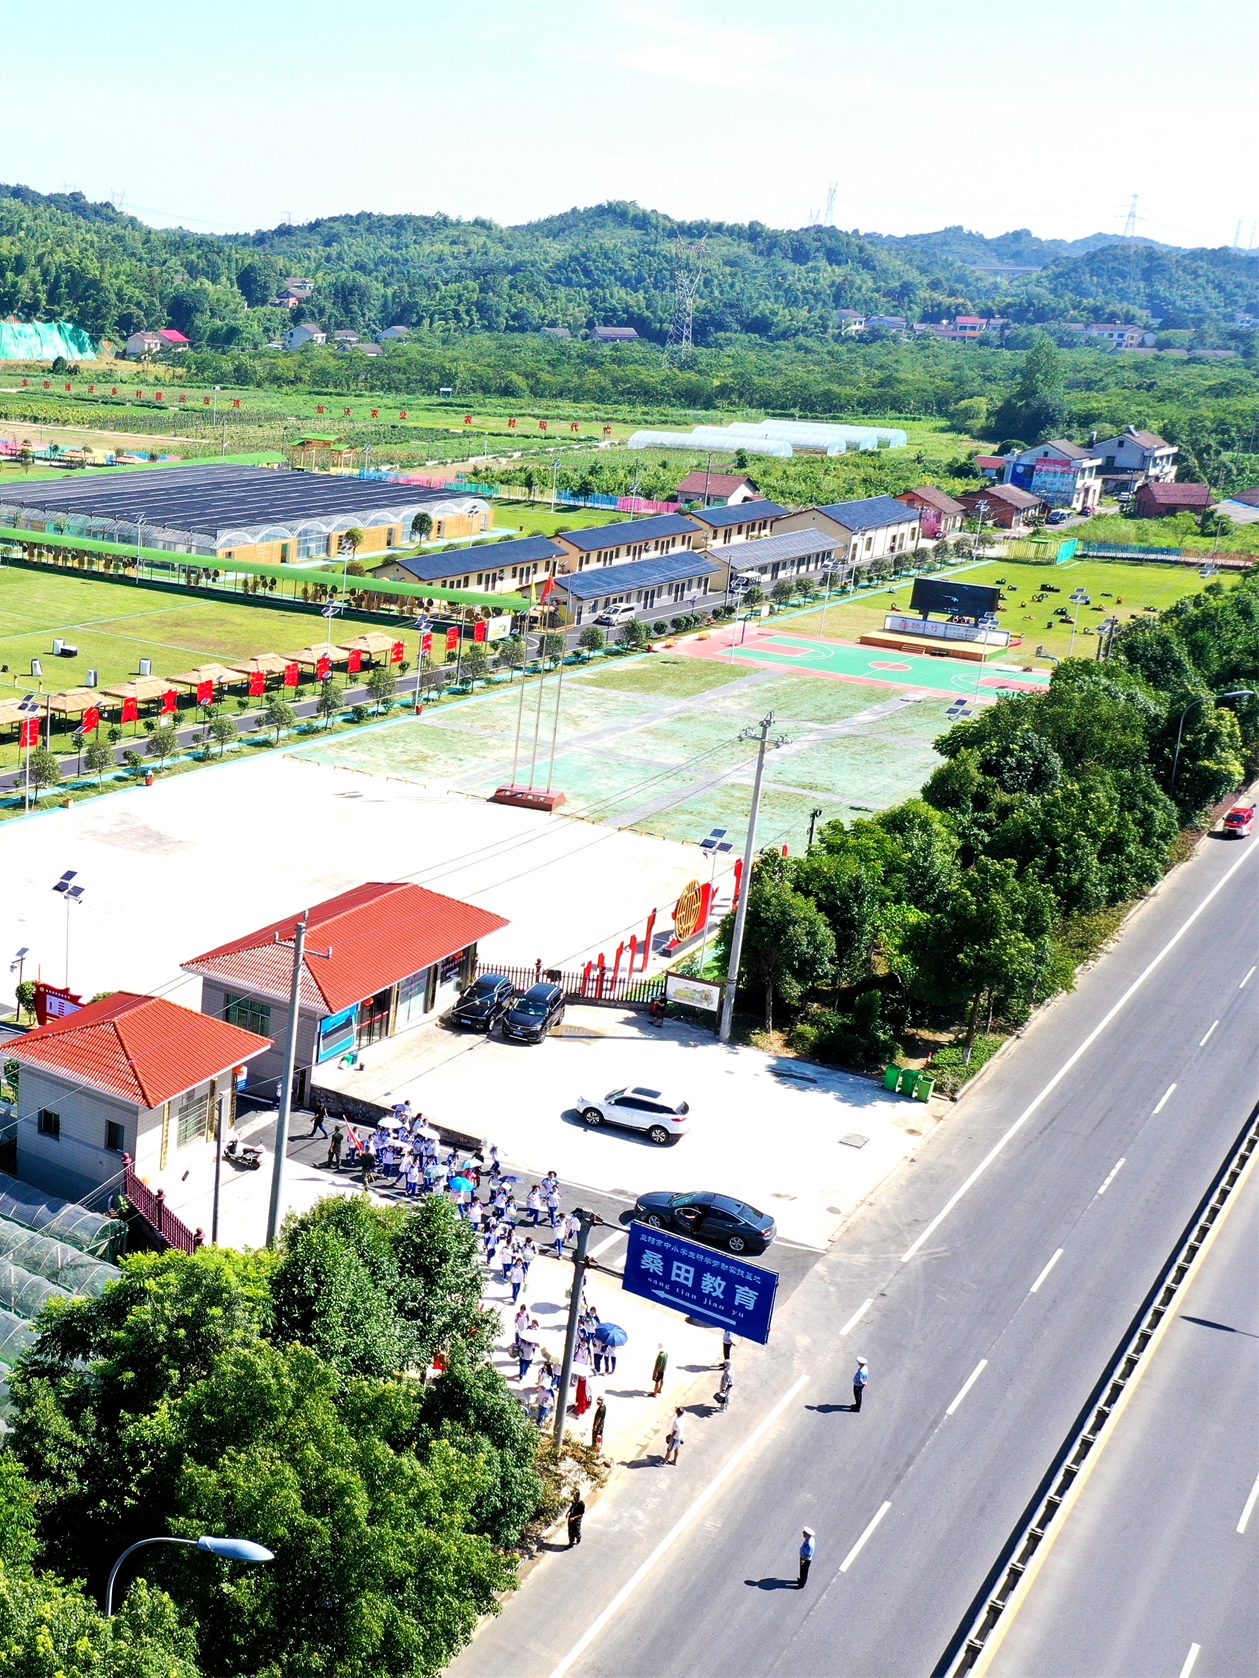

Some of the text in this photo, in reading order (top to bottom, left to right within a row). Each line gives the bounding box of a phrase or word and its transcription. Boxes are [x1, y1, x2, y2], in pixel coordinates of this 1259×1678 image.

[640, 1233, 761, 1284] 益阳市中小学生研学劳动实践基地
[640, 1249, 759, 1311] 桑田教育
[647, 1277, 745, 1319] sang tian jiao yu
